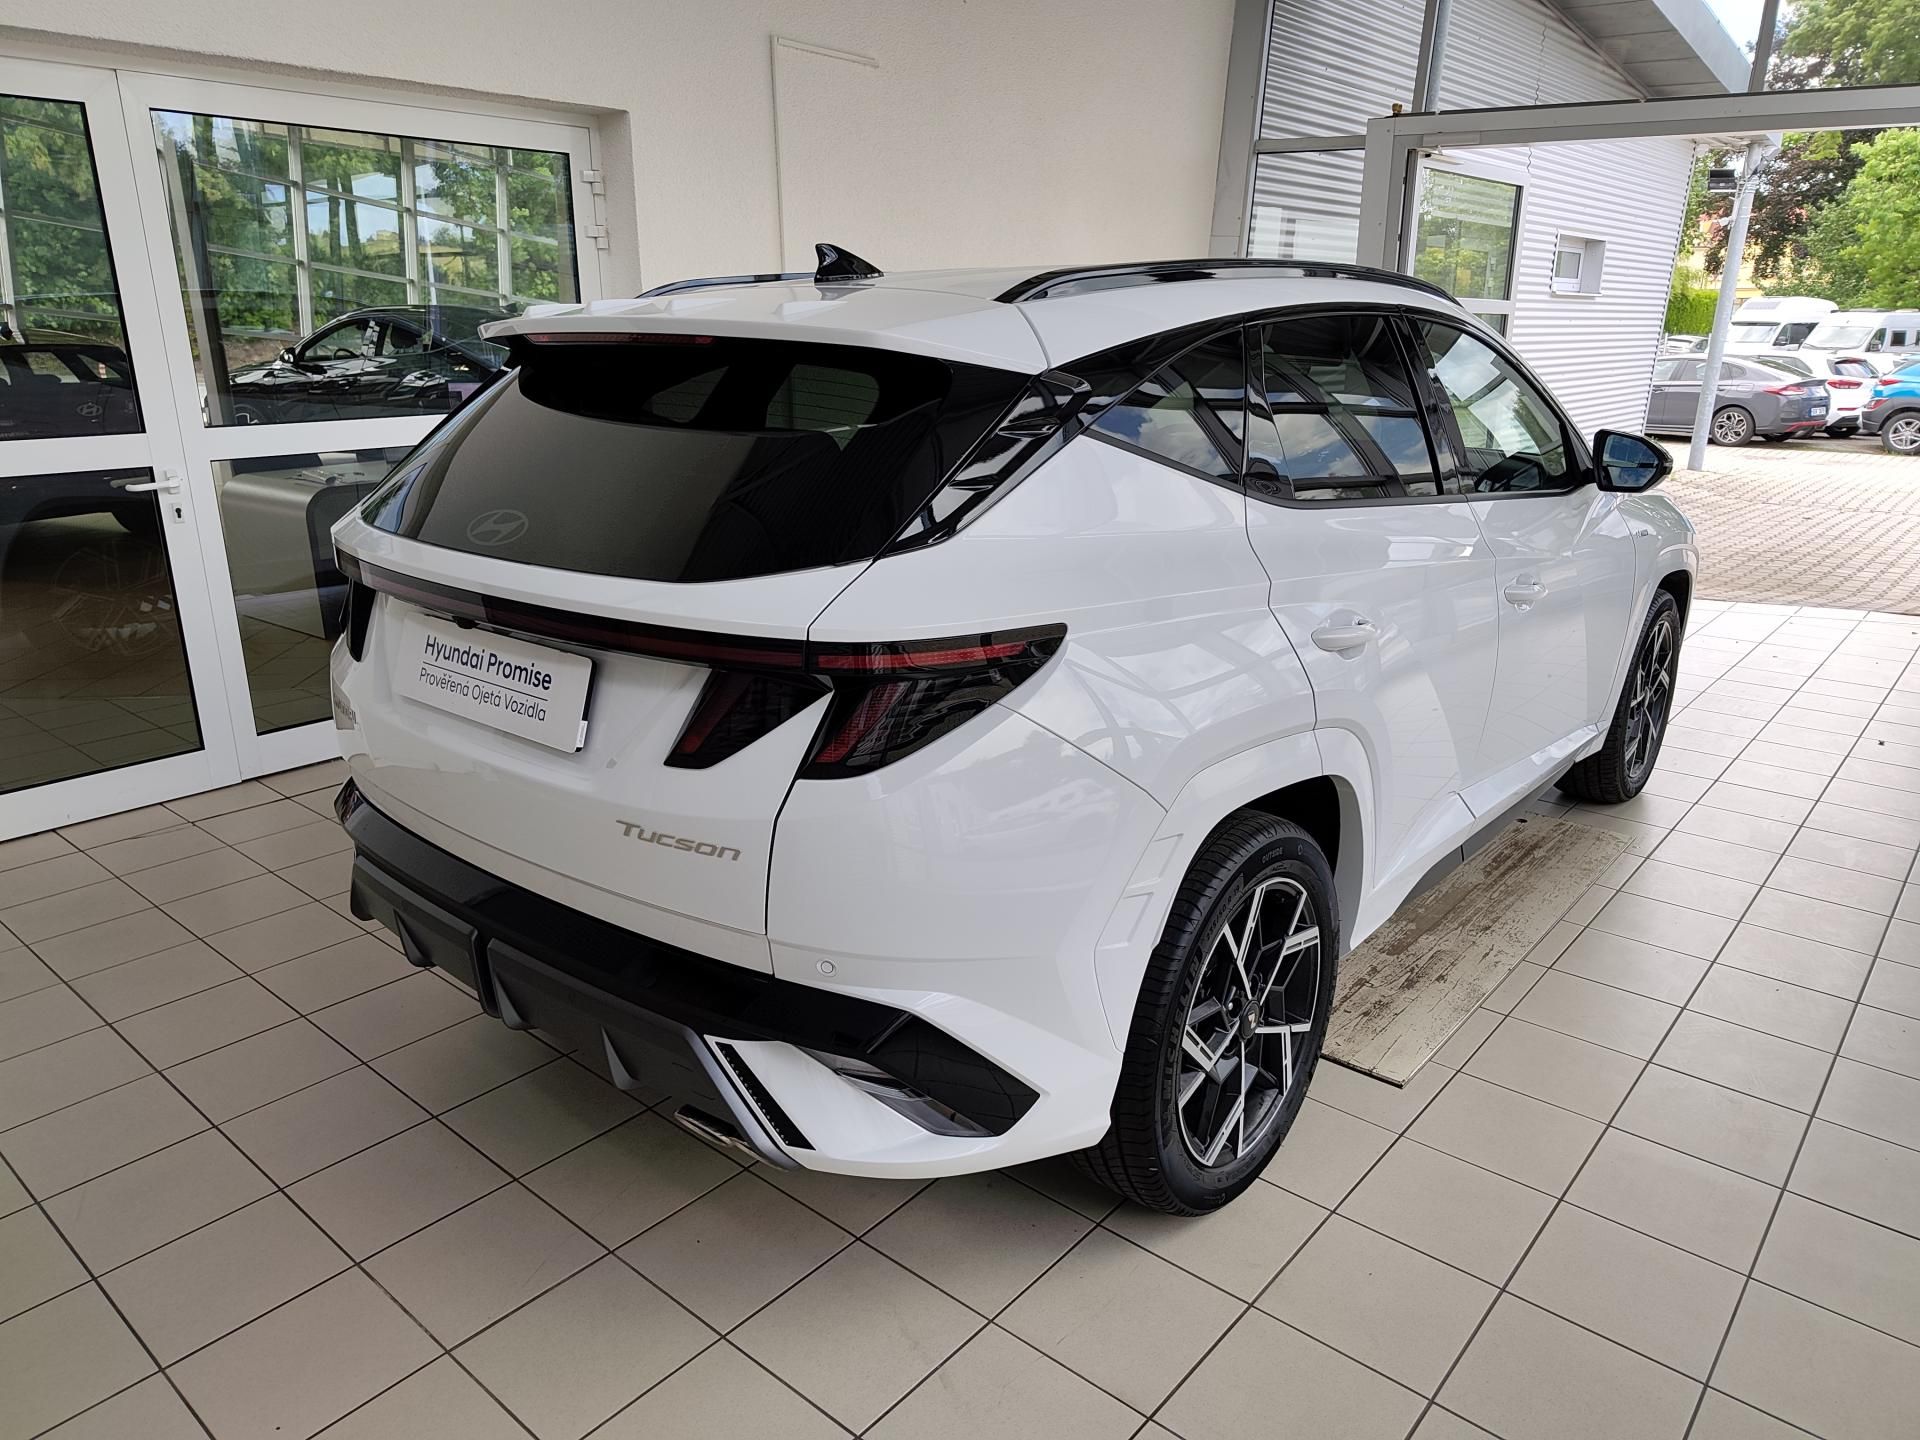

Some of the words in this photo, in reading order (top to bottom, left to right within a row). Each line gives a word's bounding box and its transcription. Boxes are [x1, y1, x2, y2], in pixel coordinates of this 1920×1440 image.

[424, 634, 485, 670] Hyundai
[486, 653, 552, 691] Promise
[419, 667, 469, 697] Prověřená
[471, 684, 501, 708] Ojetá
[504, 693, 547, 722] Vozidla
[1162, 953, 1200, 1101] MICHELIN
